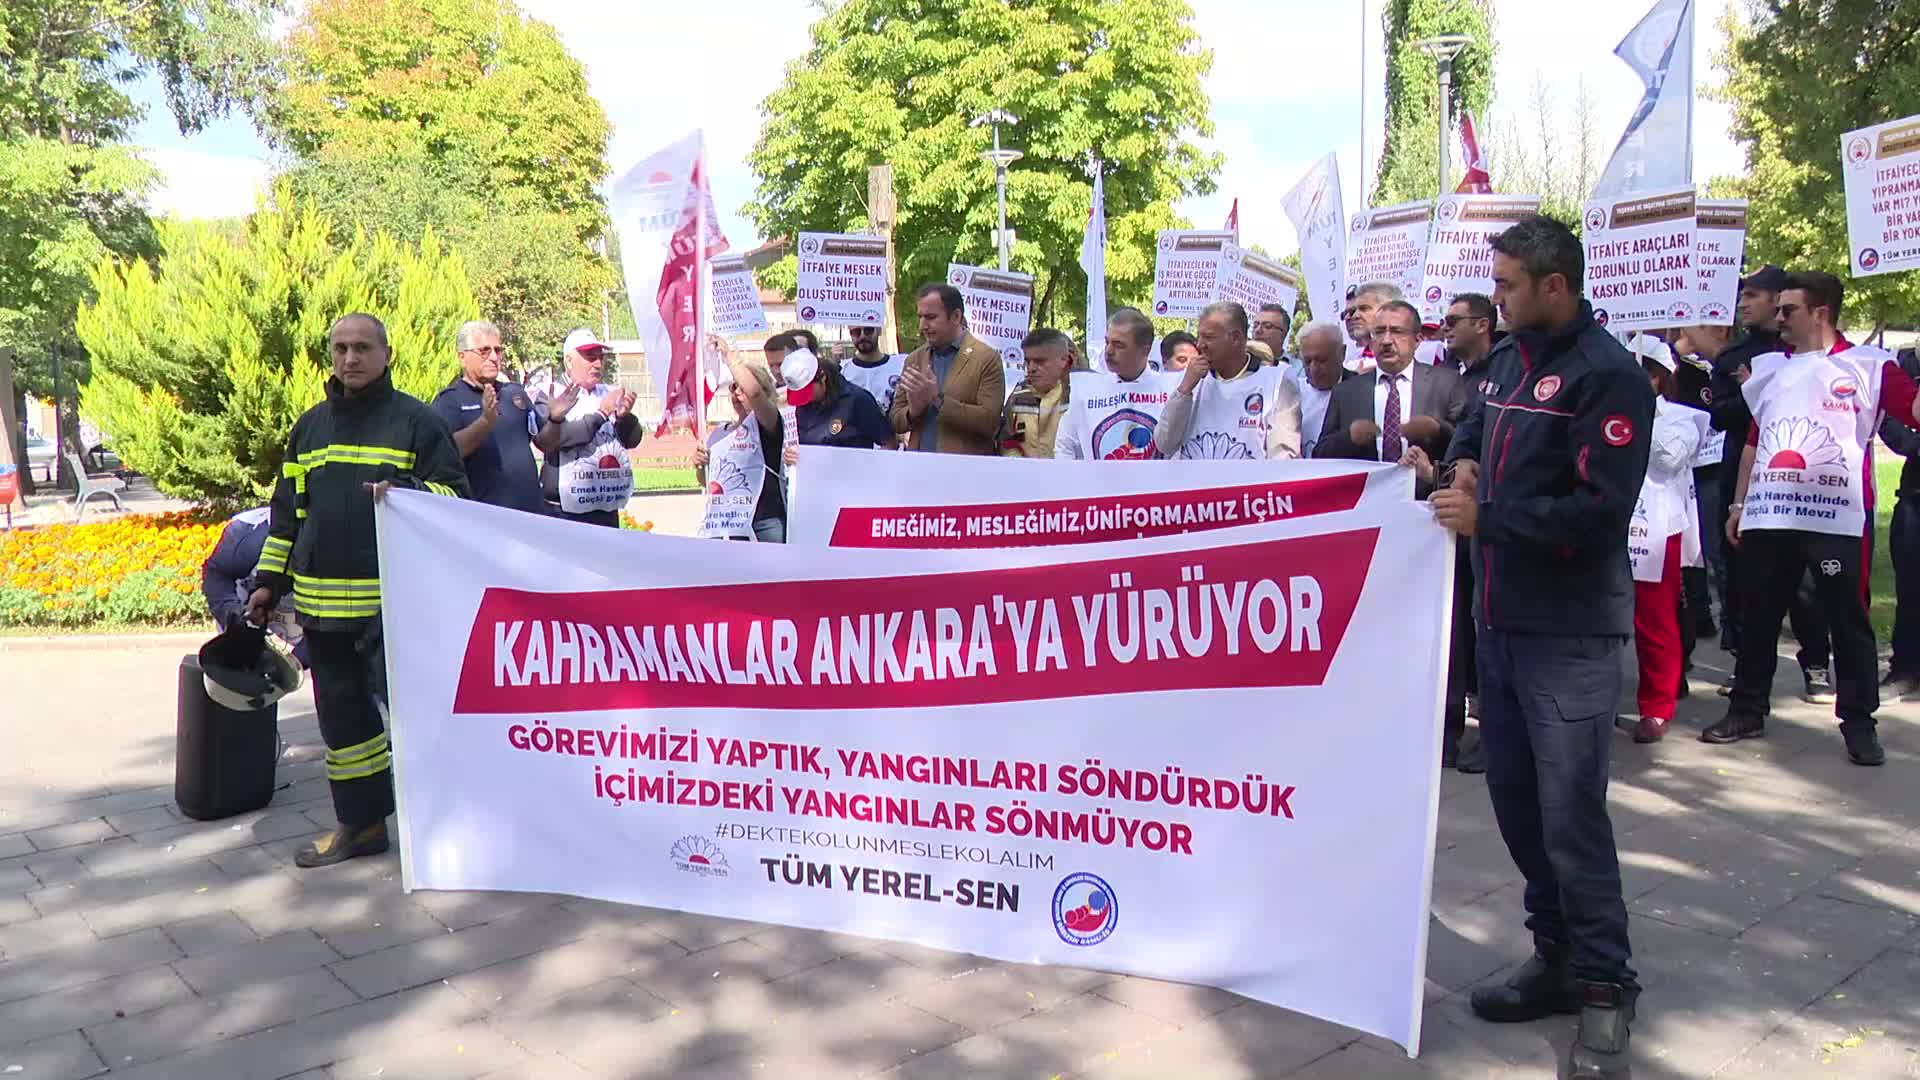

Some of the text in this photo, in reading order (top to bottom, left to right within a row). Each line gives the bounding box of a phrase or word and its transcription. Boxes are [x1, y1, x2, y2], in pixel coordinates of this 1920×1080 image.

[1872, 201, 1890, 214] VAR
[1887, 213, 1903, 227] BİR
[1435, 228, 1480, 245] İTFAİYE
[1883, 229, 1899, 243] BİR
[1588, 232, 1689, 261] İTFAİYE ARAÇLARI
[1701, 255, 1736, 266] OLARAK
[1883, 250, 1899, 260] TÜM
[802, 259, 882, 276] İTFAİYE MESLEK
[1588, 254, 1691, 280] ZORUNLU OLARAK
[825, 275, 858, 288] SINIFI
[1592, 275, 1688, 300] KASKO YAPILSIN.
[798, 287, 885, 303] OLUŞTURULSUN!
[990, 298, 1026, 314] MESLEK
[971, 309, 1003, 324] SINIFI
[1611, 311, 1626, 321] TÜM
[1087, 391, 1128, 409] BİRLEŞİK
[1763, 471, 1806, 484] YEREL
[1817, 474, 1850, 488] SEN
[732, 496, 753, 505] SEN
[1764, 491, 1851, 507] Hareketinde
[871, 513, 962, 540] EMEĞİMİZ,
[1243, 490, 1293, 523] İÇİN
[1773, 504, 1793, 515] Bir
[1795, 506, 1837, 520] Mevzi
[493, 565, 1323, 687] KAHRAMANLAR ANKARA'YA YÜRÜYOR
[507, 720, 1297, 820] GÖREVİMİZİ YAPTIK, YANGINLARI SÖNDÜRDÜK
[594, 765, 1194, 856] İÇİMİZDEKİ YANGINLAR SÖNMÜYOR
[714, 822, 1054, 871] #DEKTEKOLUNMESLEKOLALIM
[759, 853, 832, 889] TÜM
[840, 864, 1020, 913] YEREL-SEN
